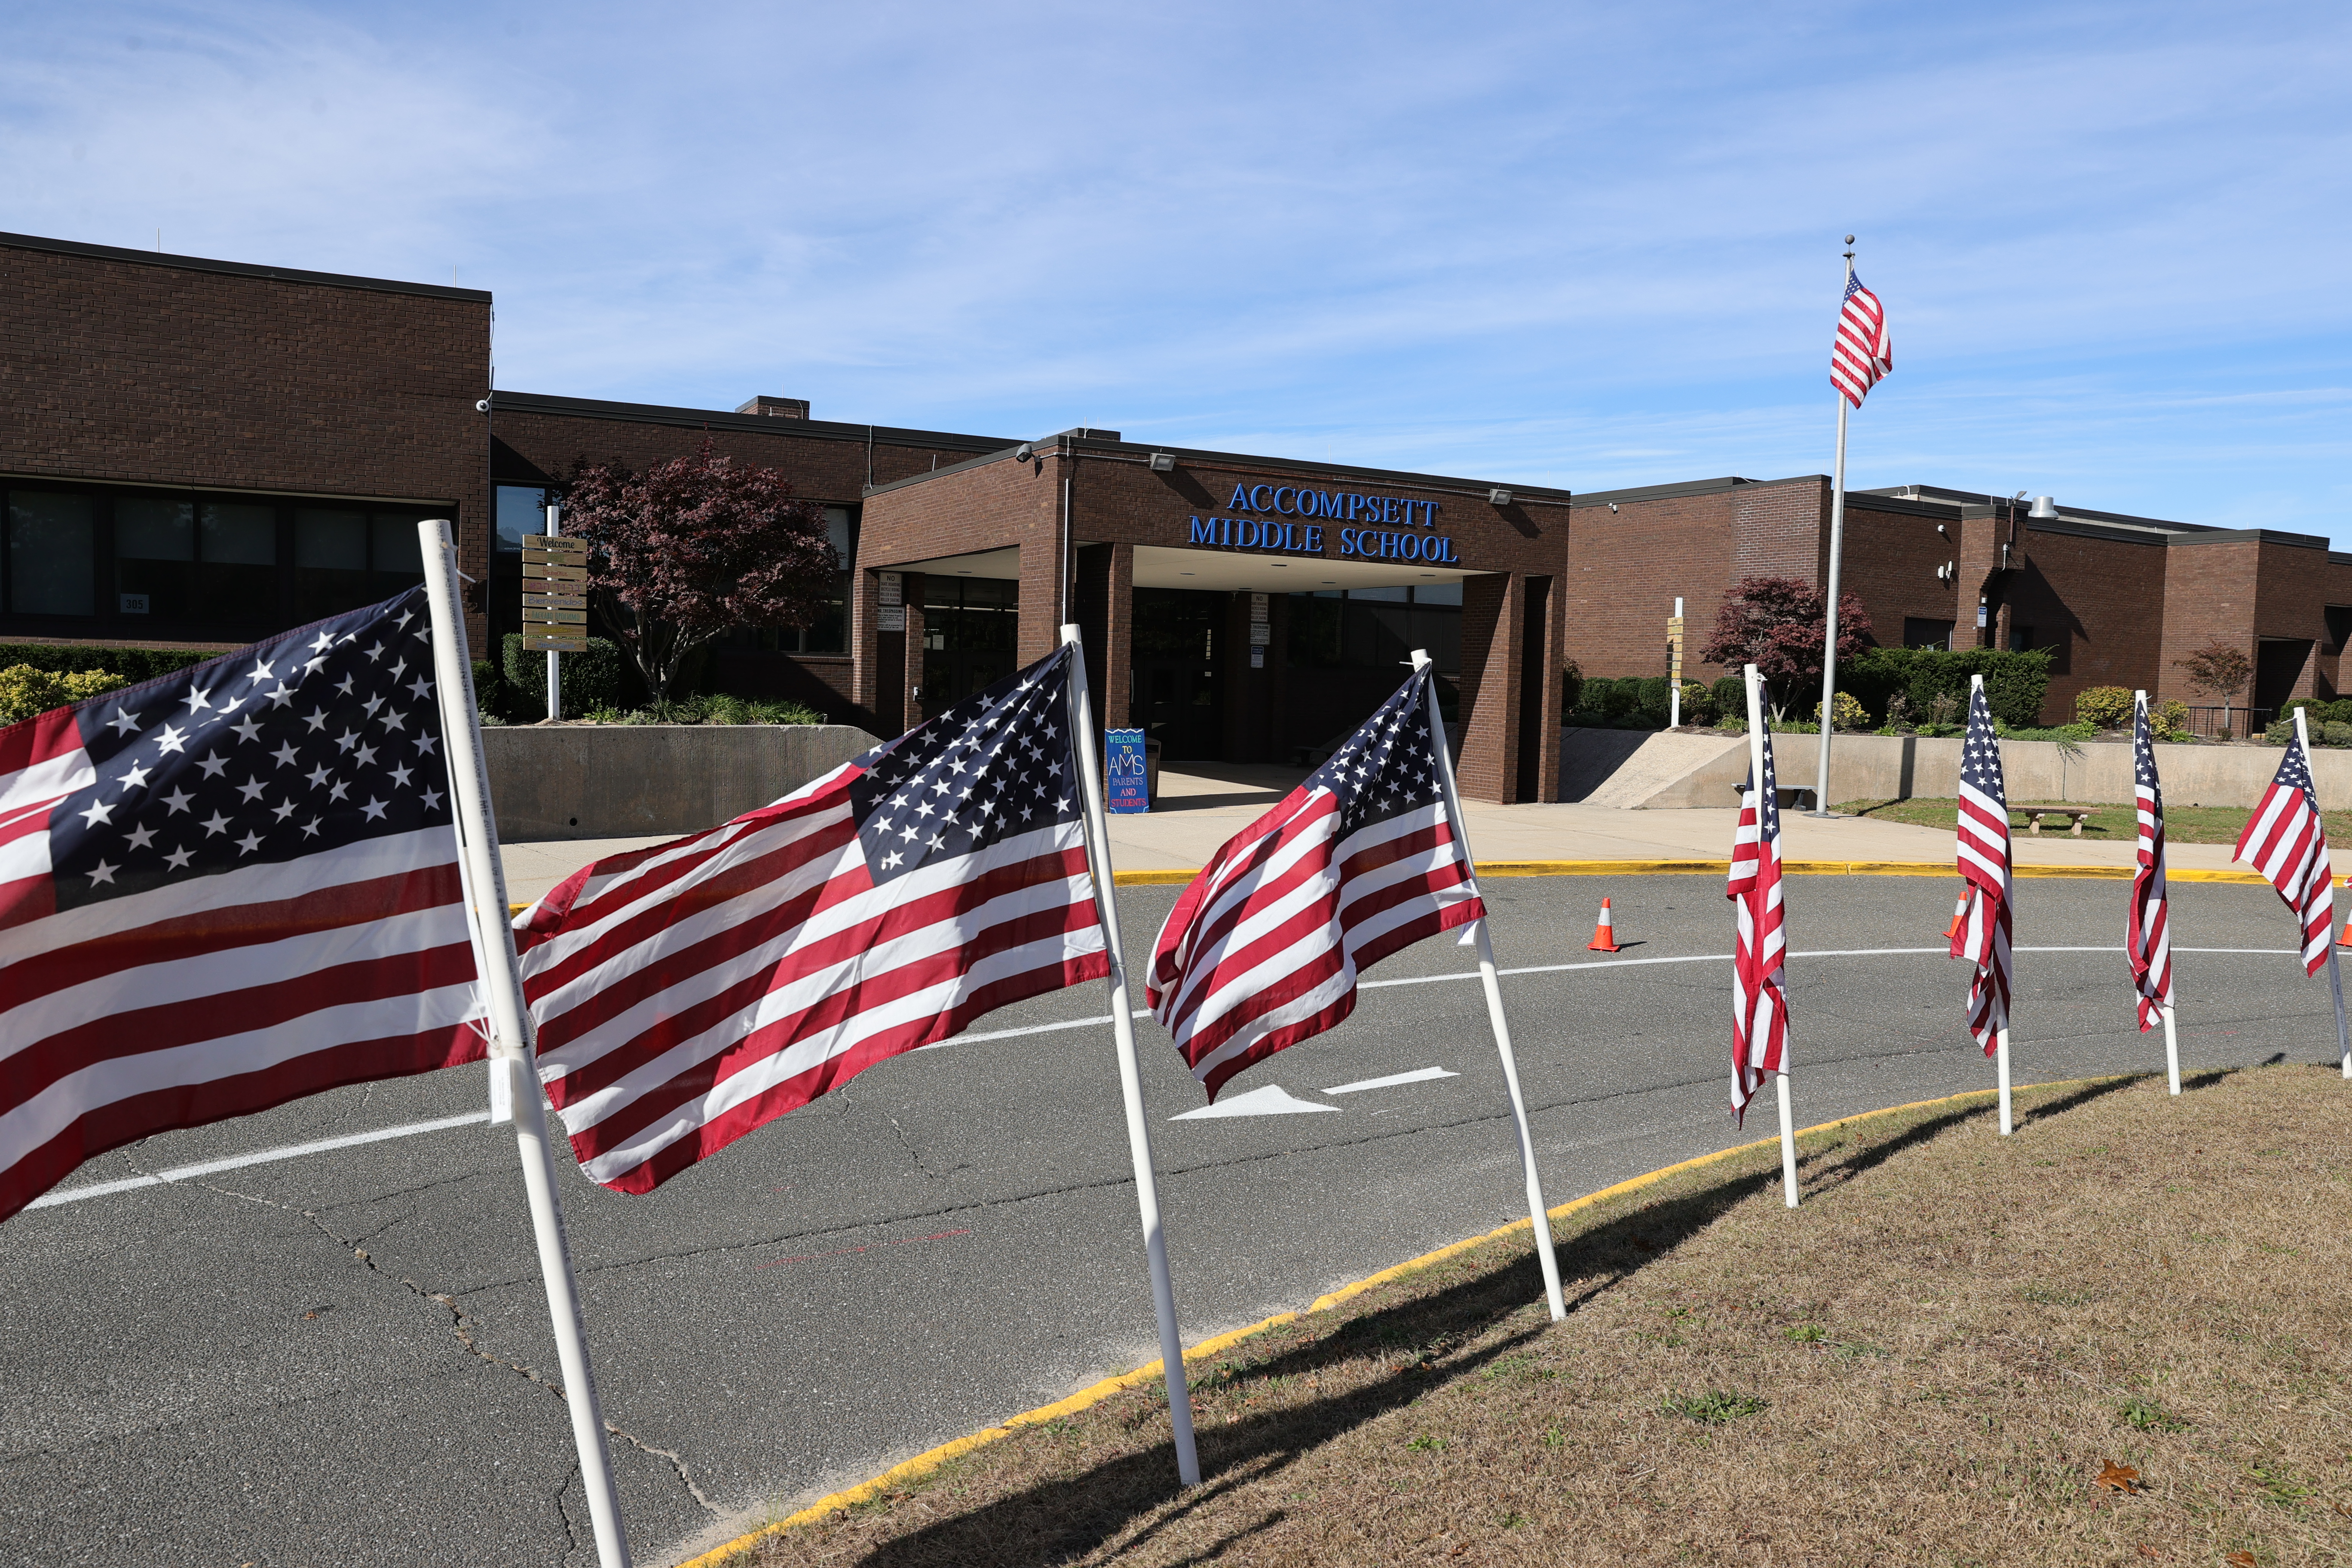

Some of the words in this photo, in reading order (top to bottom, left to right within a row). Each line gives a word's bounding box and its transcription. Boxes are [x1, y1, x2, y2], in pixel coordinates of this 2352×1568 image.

[1227, 483, 1439, 527] ACCOMPSETT
[537, 537, 575, 548] Welcome
[1189, 515, 1323, 552] MIDDLE
[1341, 528, 1458, 563] SCHOOL
[542, 567, 568, 576] Bienvenue
[126, 599, 143, 609] 305
[528, 596, 582, 606] Bienvenidos
[1109, 735, 1142, 744] WELCOME
[1122, 746, 1132, 754] TO
[1109, 754, 1144, 776] AMS
[1113, 778, 1143, 786] PARENTS
[1121, 788, 1136, 796] AND
[1111, 798, 1146, 807] STUDENTS
[556, 1211, 564, 1226] JM
[559, 1228, 572, 1264] EAGLE
